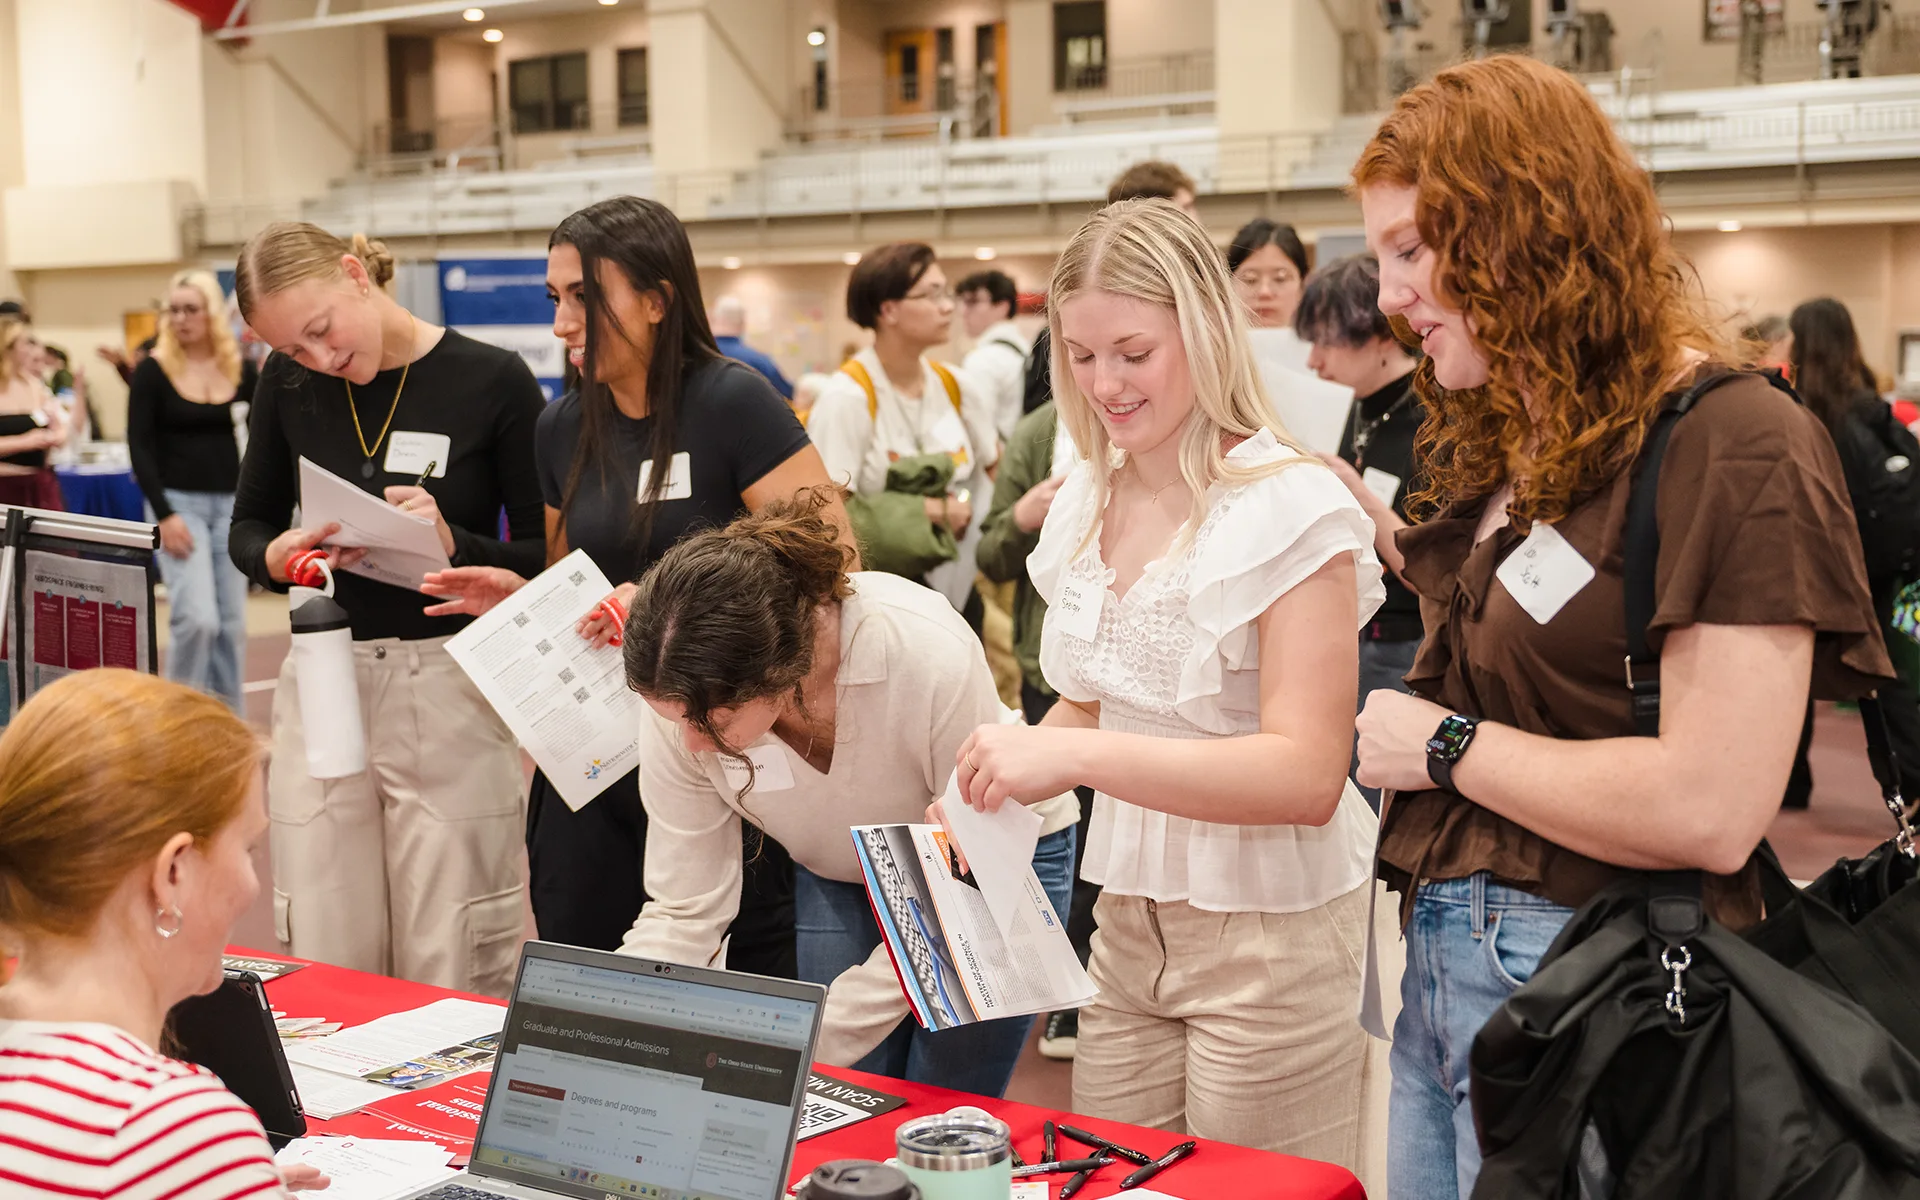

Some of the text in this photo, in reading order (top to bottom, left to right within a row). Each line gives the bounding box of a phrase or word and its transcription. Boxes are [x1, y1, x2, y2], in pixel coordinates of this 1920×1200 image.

[233, 959, 285, 971] SCAN
[957, 933, 990, 1008] MASTER OF SCIENCE IN
[964, 940, 994, 1008] HEALTH INFORMATICS
[521, 1018, 671, 1057] Graduate and Professional Admissions
[738, 1060, 754, 1070] STATE
[753, 1063, 784, 1076] UNIVERSITY
[569, 1091, 658, 1120] Degrees and programs
[825, 1086, 885, 1107] SCAN
